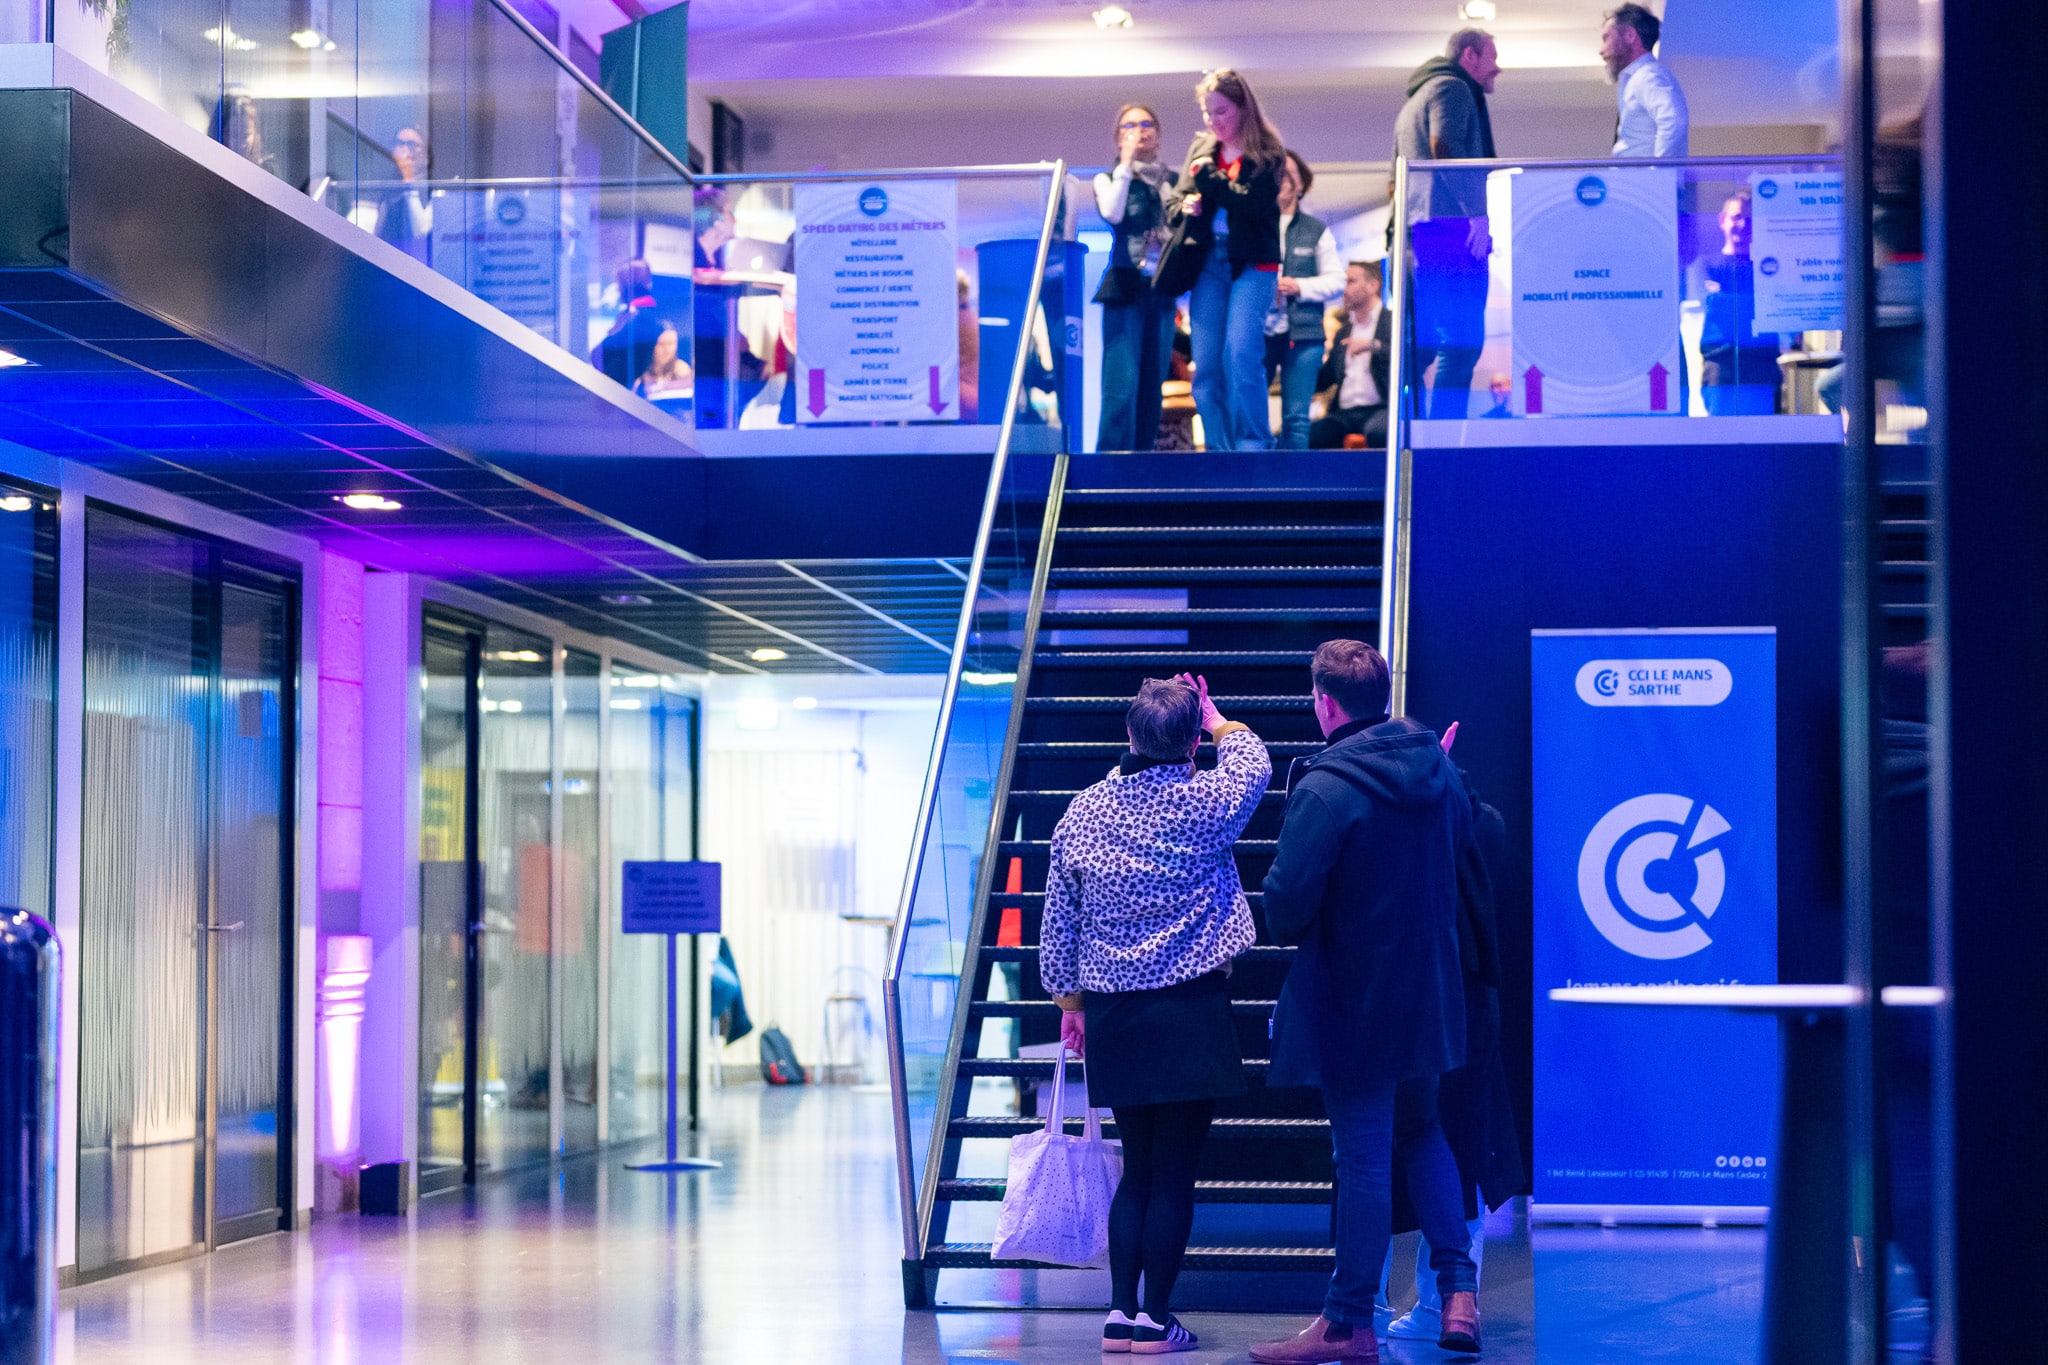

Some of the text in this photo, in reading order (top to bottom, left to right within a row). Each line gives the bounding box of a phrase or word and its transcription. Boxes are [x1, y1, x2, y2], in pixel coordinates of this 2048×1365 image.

[1794, 181, 1821, 190] Table
[802, 219, 946, 234] SPEED DATING DES MÉTIERS
[851, 238, 897, 247] HÔTELLERIE
[845, 254, 903, 262] RESTAURATION
[1796, 258, 1823, 267] Table
[834, 268, 868, 278] MÉTIERS
[882, 269, 914, 277] BOUCHE
[1574, 269, 1610, 279] ESPACE
[836, 285, 880, 294] COMMERCE
[1523, 289, 1663, 302] MOBILITÉ PROFESSIONNELLE
[830, 300, 919, 309] GRANDE DISTRIBUTION
[851, 316, 898, 324] TRANSPORT
[856, 330, 893, 339] MOBILITÉ
[850, 347, 900, 355] AUTOMOBILE
[861, 362, 889, 370] POLICE
[844, 376, 869, 386] ARMÉE
[1628, 669, 1713, 681] CCI LE MANS
[1628, 684, 1682, 696] SARTHE
[1736, 1171, 1761, 1179] Cedex
